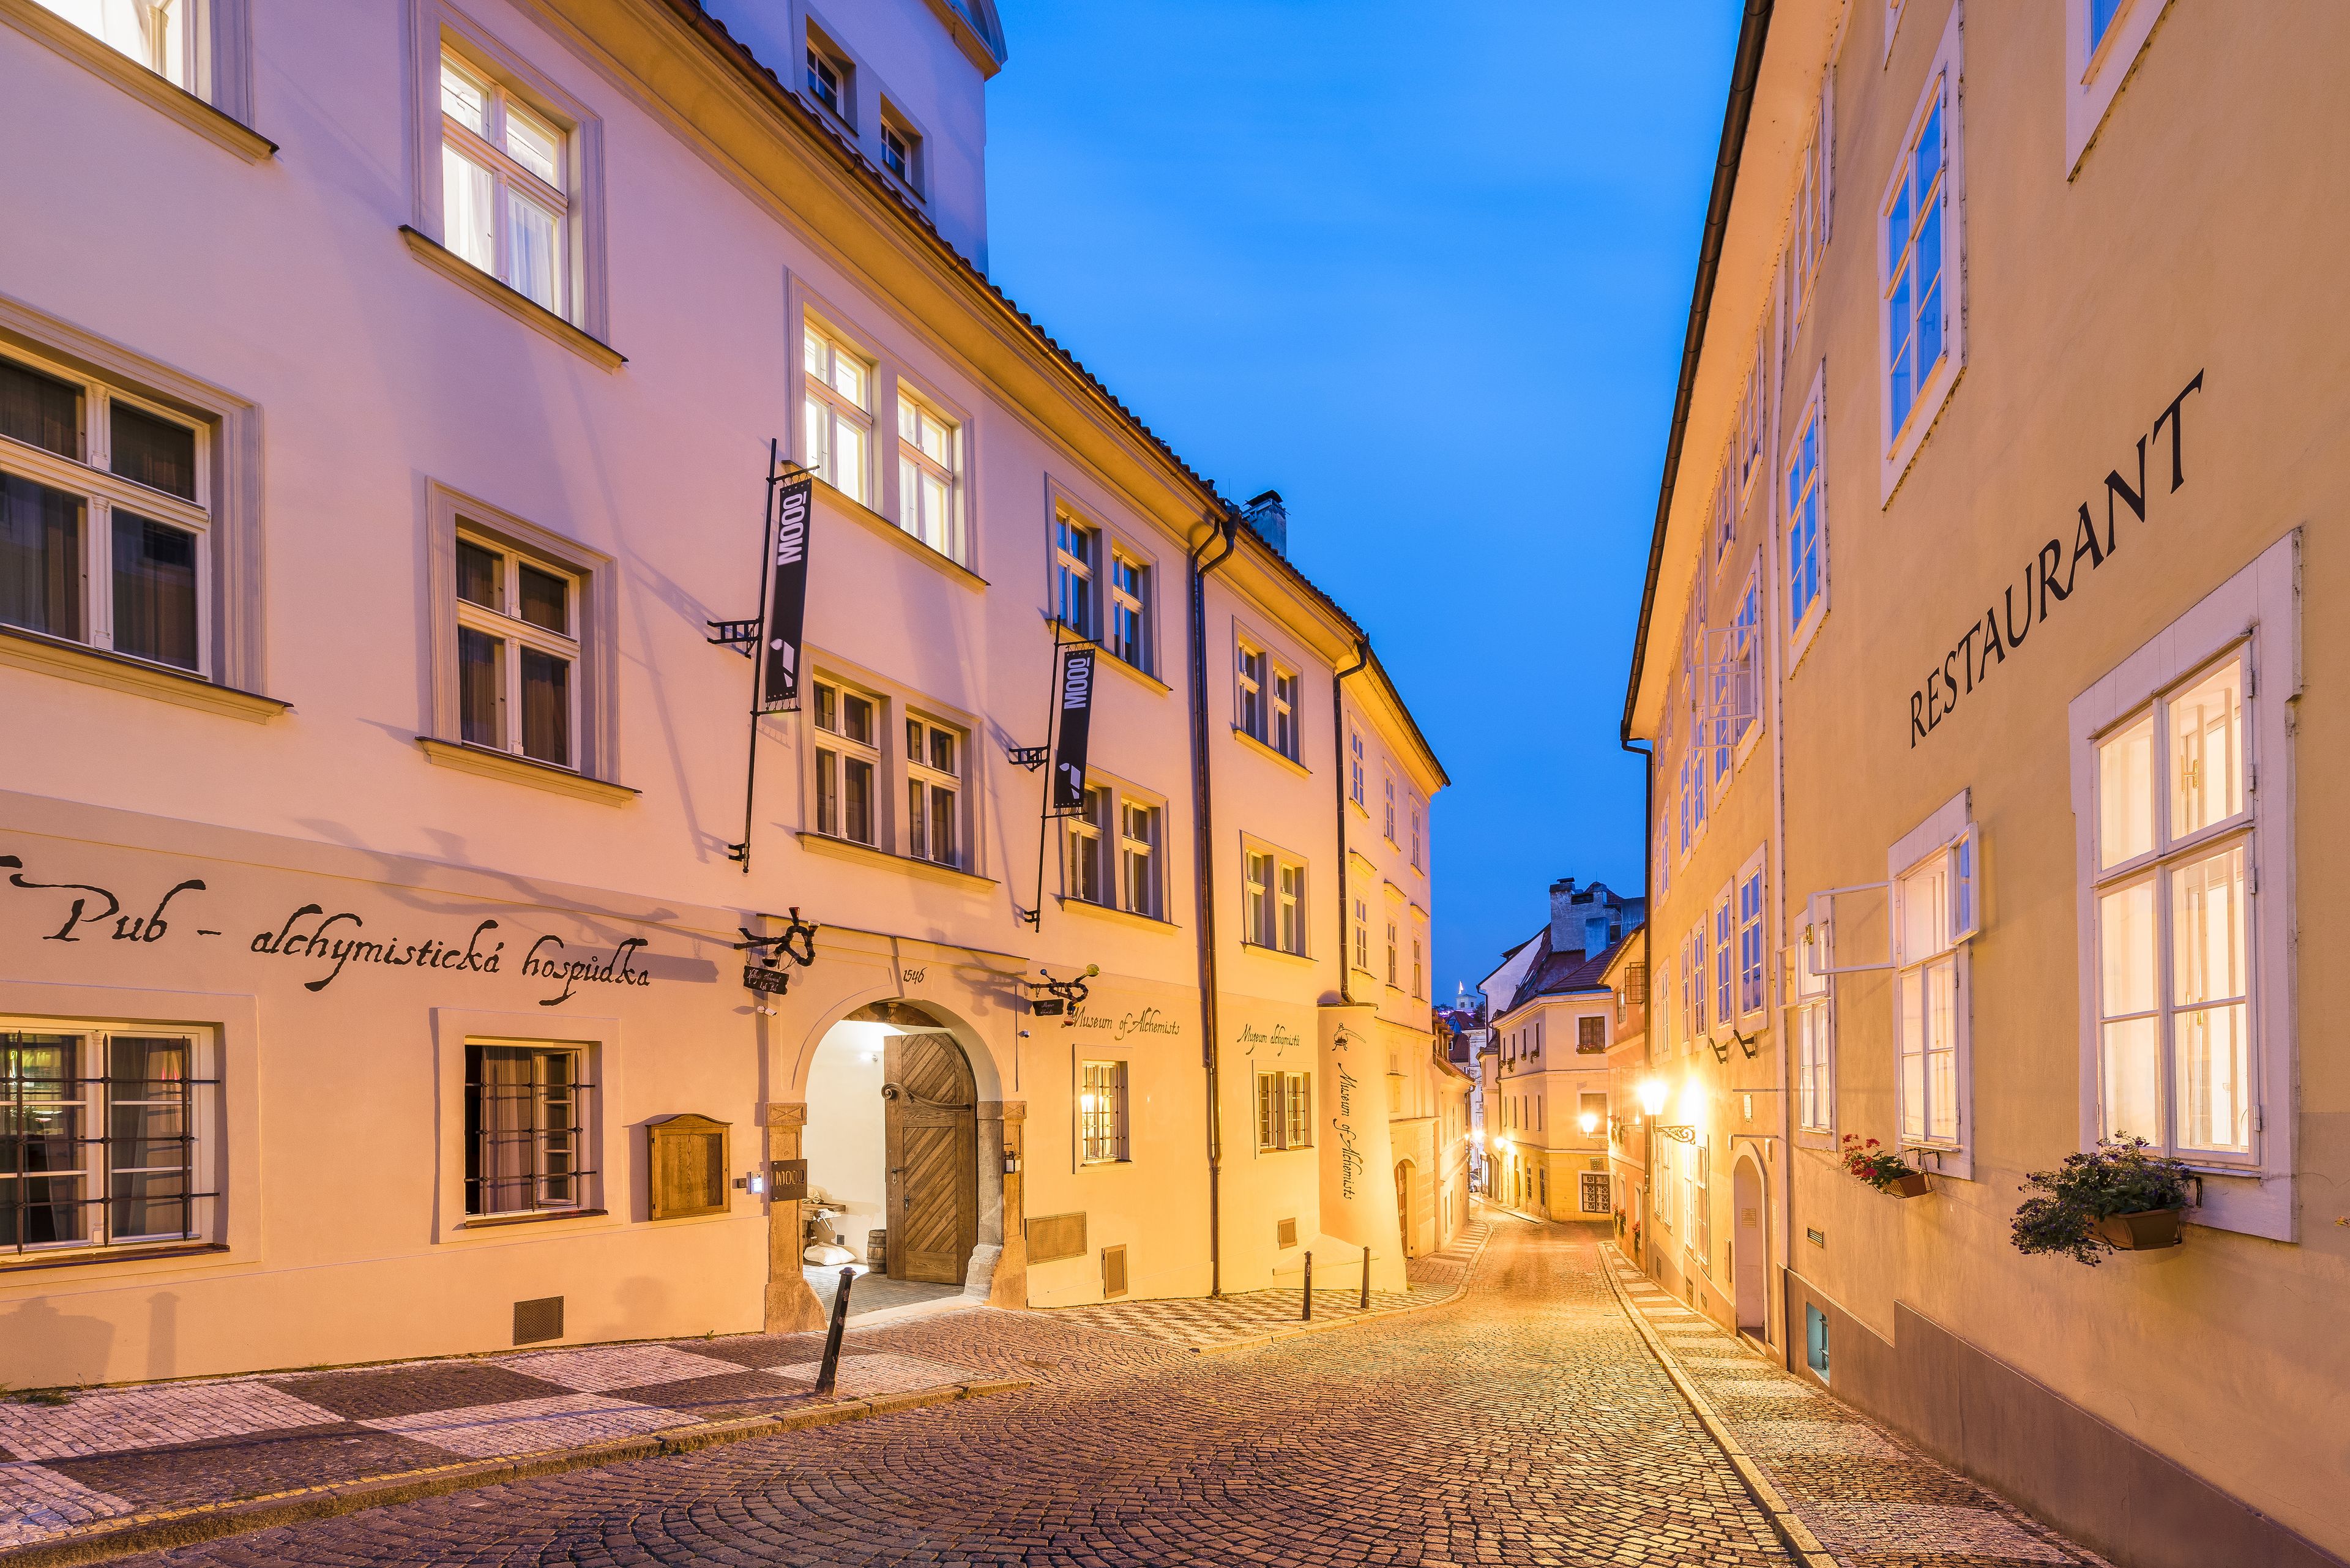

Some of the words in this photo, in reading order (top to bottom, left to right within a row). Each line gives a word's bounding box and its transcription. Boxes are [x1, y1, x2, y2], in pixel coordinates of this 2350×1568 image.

[1910, 366, 2205, 750] RESTAURANT
[9, 873, 207, 943] Pub
[250, 903, 504, 992] alchymistická
[521, 935, 651, 1007] hospůdka
[903, 966, 928, 985] 1546
[1061, 1006, 1113, 1029] Museum
[1114, 1013, 1133, 1040] of
[1127, 1007, 1180, 1035] Alchemists
[1236, 1023, 1267, 1055] Muzeum
[1337, 1062, 1358, 1116] Museum
[1333, 1118, 1357, 1140] of
[1340, 1133, 1363, 1200] Alchemists
